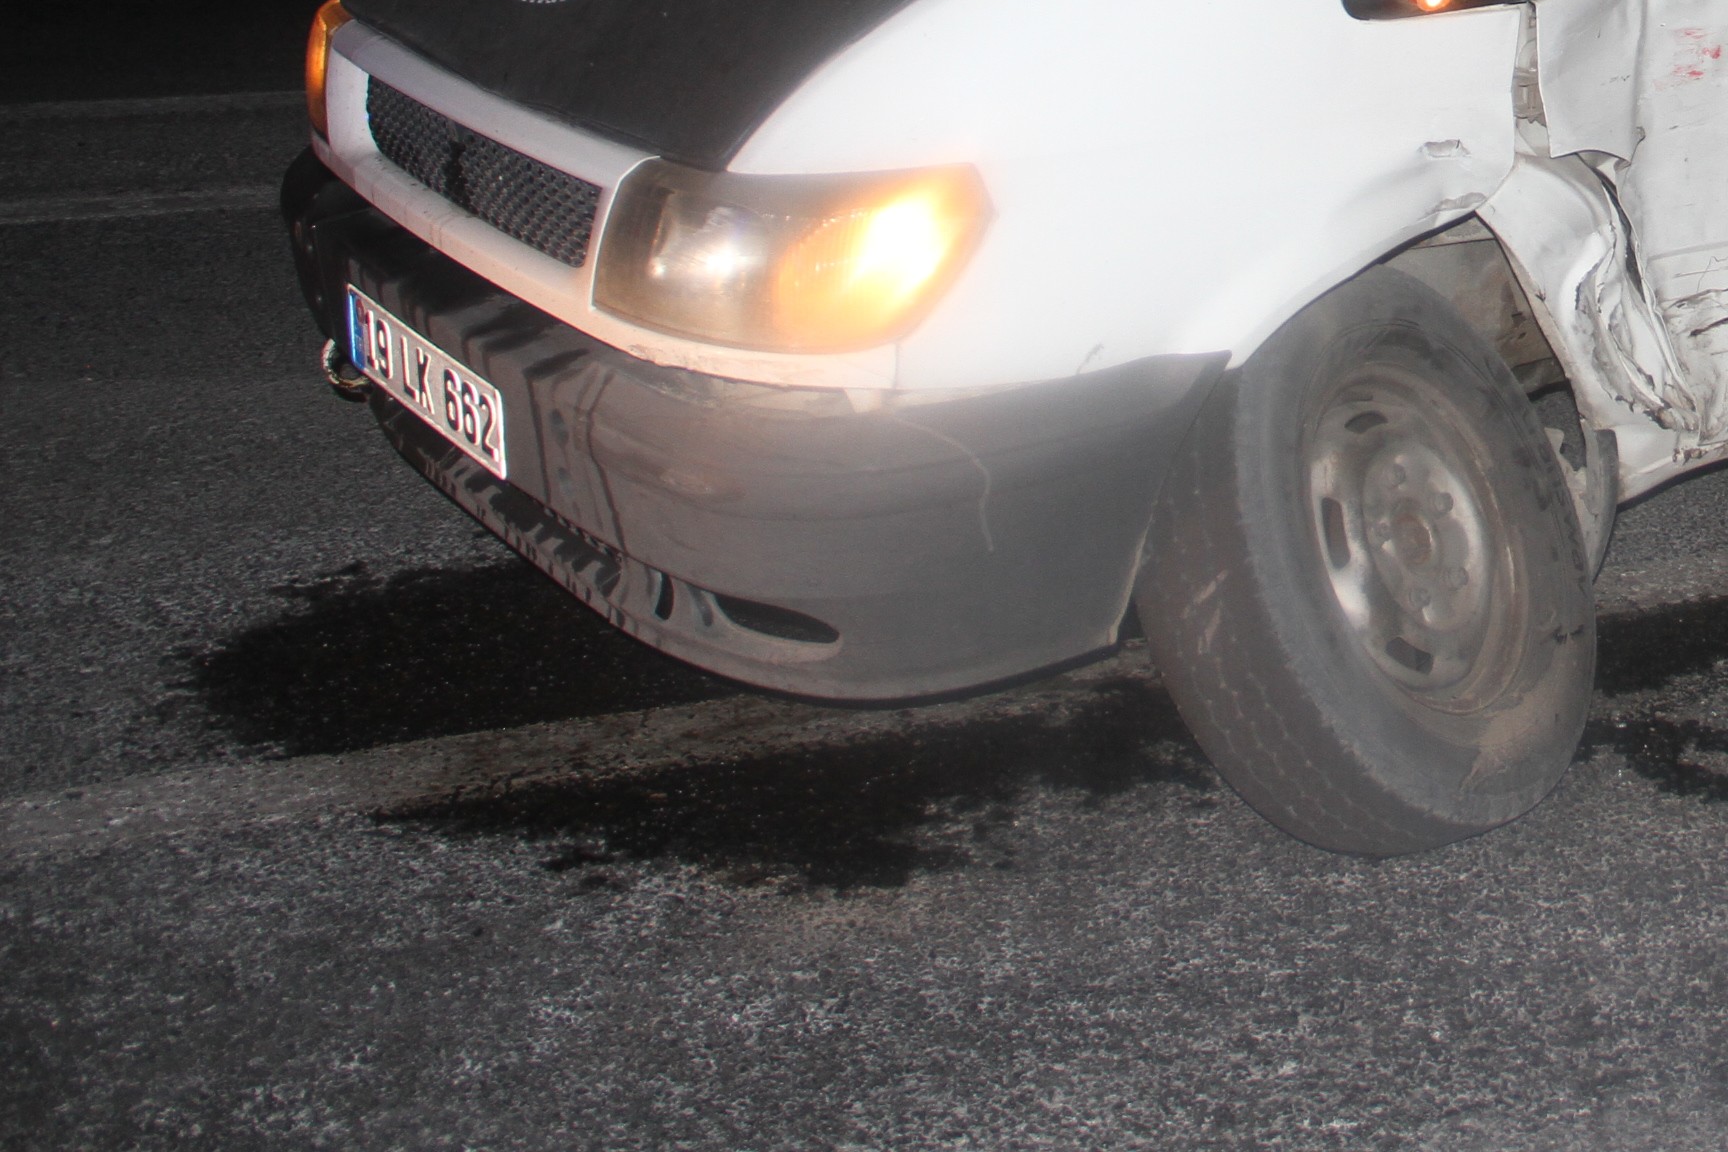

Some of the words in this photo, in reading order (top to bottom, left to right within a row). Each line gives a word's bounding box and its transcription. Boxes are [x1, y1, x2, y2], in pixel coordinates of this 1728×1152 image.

[365, 309, 394, 380] 19
[400, 334, 436, 415] LK
[444, 367, 500, 463] 662
